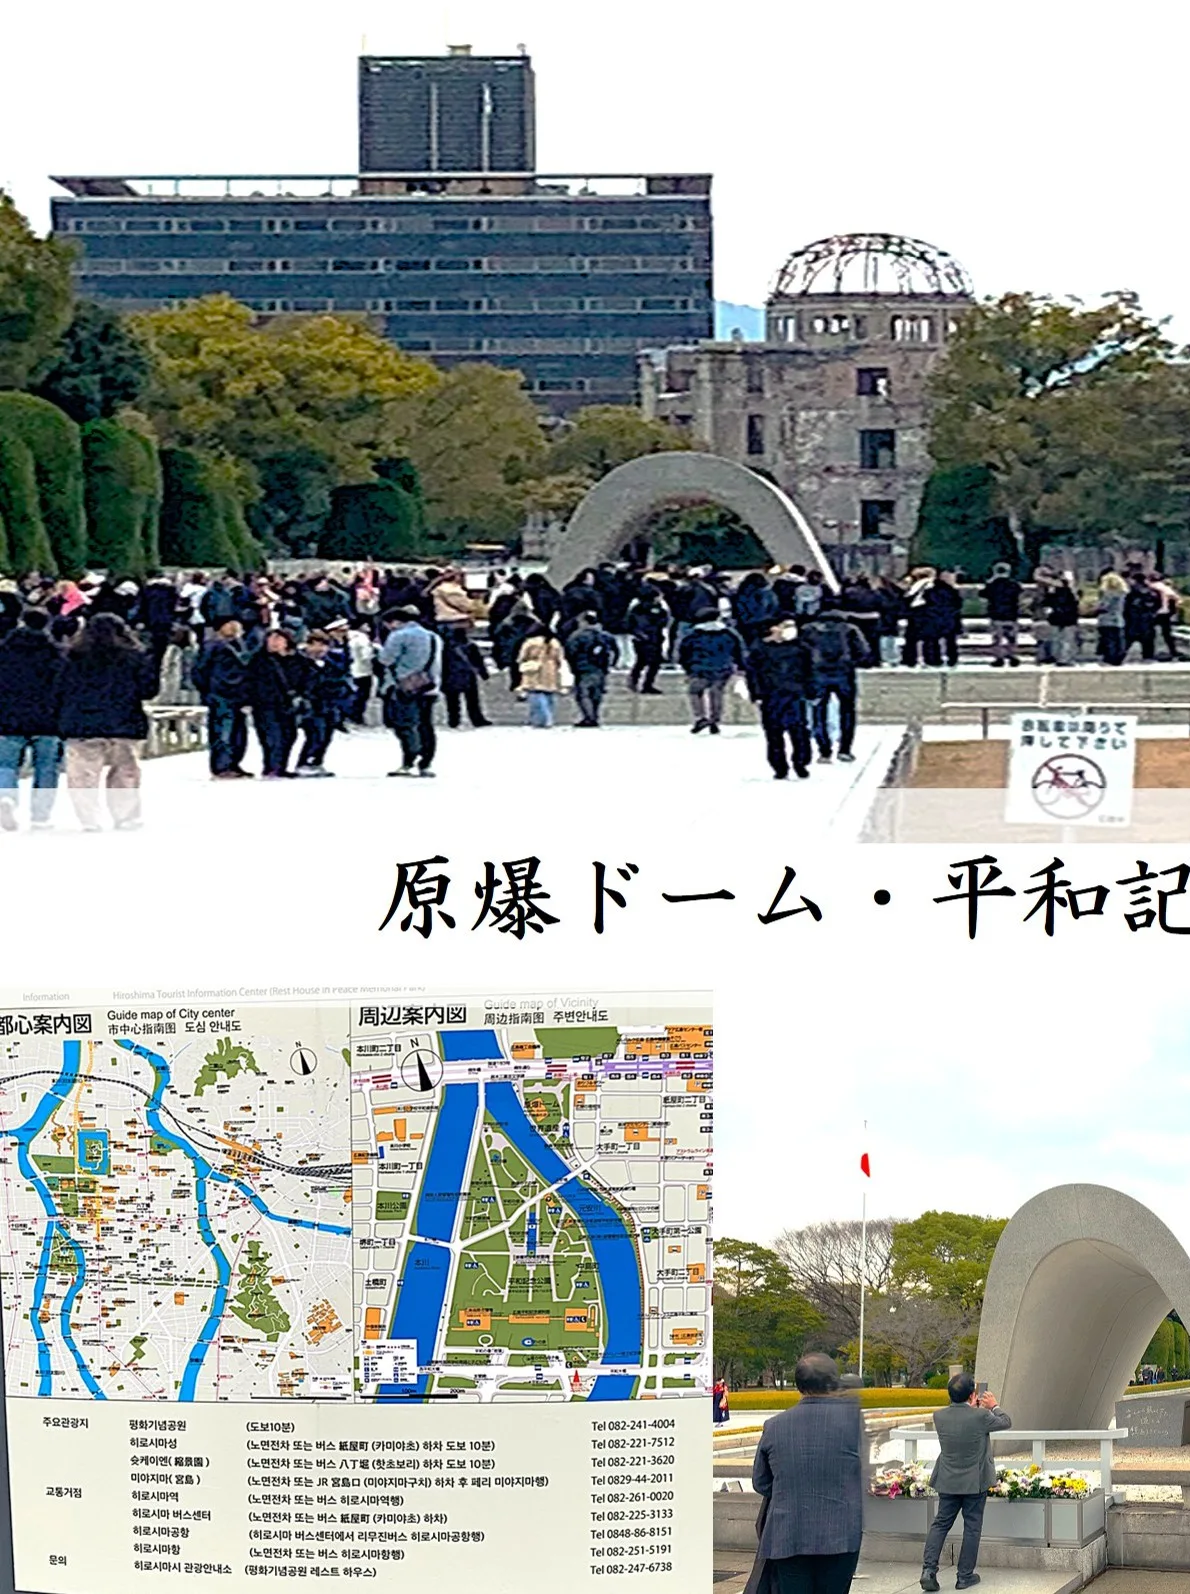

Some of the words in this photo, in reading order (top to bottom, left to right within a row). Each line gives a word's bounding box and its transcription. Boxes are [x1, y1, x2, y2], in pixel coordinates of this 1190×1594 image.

[22, 992, 69, 1001] Information
[112, 990, 155, 999] Hiroshima
[156, 989, 186, 998] Tourist
[186, 988, 236, 997] Information
[238, 987, 268, 996] Center
[269, 987, 291, 996] (Rest
[291, 986, 320, 994] House
[484, 999, 517, 1010] Guide
[520, 999, 544, 1010] map
[547, 998, 558, 1009] of
[561, 998, 599, 1009] Vicinity
[108, 1010, 138, 1020] Guide
[141, 1011, 163, 1021] map
[166, 1009, 177, 1018] of
[178, 1008, 199, 1020] City
[202, 1008, 235, 1018] center
[484, 1012, 544, 1025] 周边指南图
[553, 1010, 608, 1022] 주변안내도
[0, 1013, 92, 1035] 都心案内図
[108, 1023, 176, 1035] 市中心指南图
[185, 1021, 205, 1032] 도심
[209, 1020, 242, 1032] 안내도
[411, 1038, 419, 1047] N
[42, 1416, 88, 1428] 주요관광지
[129, 1419, 186, 1431] 평화기념공원
[245, 1421, 294, 1433] (도보10분)
[591, 1420, 606, 1431] Tel
[607, 1418, 675, 1430] 082-241-4004
[129, 1437, 176, 1449] 히로시마성
[246, 1439, 289, 1450] (노면전차
[292, 1440, 312, 1451] 또는
[315, 1440, 335, 1451] 버스
[371, 1440, 419, 1451] (카미야초)
[422, 1440, 443, 1451] 하차
[445, 1440, 466, 1450] 도보
[469, 1440, 495, 1451] 10분)
[591, 1439, 605, 1449] Tel
[607, 1436, 674, 1448] 082-221-7512
[246, 1457, 290, 1468] (노면전차
[293, 1458, 313, 1469] 또는
[315, 1458, 336, 1469] 버스
[371, 1458, 419, 1470] (핫초보리)
[422, 1458, 443, 1469] 하차
[445, 1459, 466, 1468] 도보
[469, 1458, 495, 1469] 10분)
[591, 1457, 605, 1467] Tel
[607, 1454, 674, 1467] 082-221-3620
[247, 1475, 290, 1487] (노면전차
[293, 1476, 313, 1487] 또는
[316, 1477, 328, 1486] JR
[363, 1476, 431, 1488] (미야지마구치)
[434, 1476, 454, 1488] 하차
[457, 1476, 468, 1487] 후
[470, 1476, 491, 1487] 페리
[494, 1475, 548, 1487] 미야지마행)
[590, 1475, 605, 1485] Tel
[607, 1473, 672, 1485] 0829-44-2011
[45, 1486, 81, 1498] 교통거점
[131, 1490, 178, 1502] 히로시마역
[590, 1493, 605, 1503] Tel
[607, 1490, 673, 1503] 082-261-0020
[247, 1493, 291, 1504] (노면전차
[294, 1494, 314, 1505] 또는
[316, 1494, 337, 1505] 버스
[340, 1494, 403, 1506] 히로시마역행)
[132, 1507, 169, 1519] 히로시마
[172, 1509, 210, 1521] 버스센터
[248, 1511, 291, 1523] (노면전차
[294, 1512, 314, 1523] 또는
[317, 1512, 337, 1523] 버스
[372, 1513, 420, 1524] (카미야초)
[423, 1513, 447, 1524] 하차)
[590, 1511, 604, 1521] Tel
[606, 1508, 673, 1521] 082-225-3133
[132, 1525, 189, 1538] 히로시마공항
[248, 1529, 292, 1540] (히로시마
[294, 1530, 354, 1541] 버스센터에서
[357, 1531, 407, 1542] 리무진버스
[410, 1531, 484, 1542] 히로시마공항행)
[590, 1529, 604, 1539] Tel
[606, 1526, 671, 1538] 0848-86-8151
[133, 1543, 180, 1555] 히로시마항
[249, 1547, 292, 1558] (노면전차
[295, 1548, 314, 1559] 또는
[317, 1548, 338, 1559] 버스
[341, 1548, 404, 1560] 히로시마항행)
[590, 1547, 604, 1557] Tel
[606, 1544, 671, 1556] 082-251-5191
[49, 1554, 66, 1565] 문의
[134, 1560, 180, 1572] 히로시마시
[183, 1562, 232, 1574] 관광안내소
[244, 1564, 306, 1576] (평화기념공원
[309, 1566, 340, 1576] 레스트
[342, 1566, 376, 1577] 하우스)
[590, 1564, 604, 1574] Tel
[606, 1561, 672, 1574] 082-247-6738
